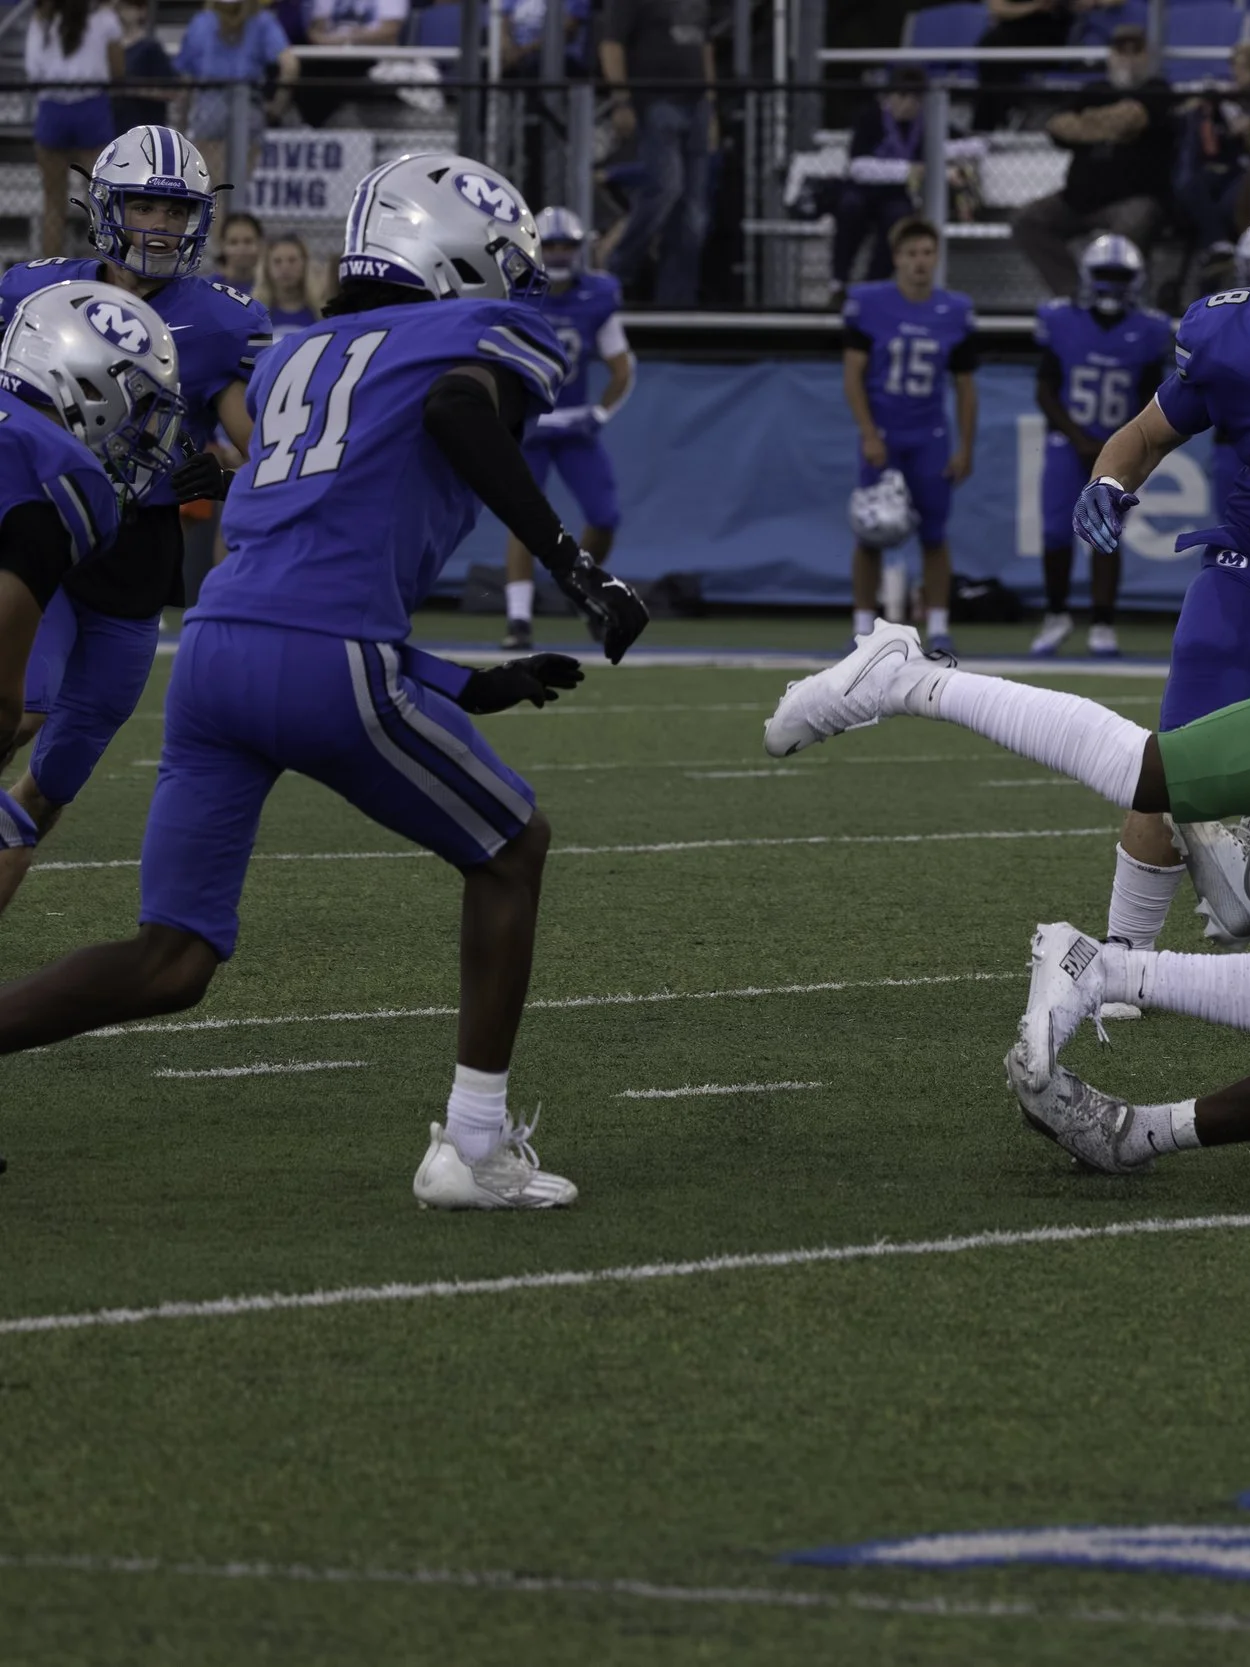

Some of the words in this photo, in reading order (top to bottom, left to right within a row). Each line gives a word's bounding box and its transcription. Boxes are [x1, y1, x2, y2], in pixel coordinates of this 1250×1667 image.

[149, 178, 181, 188] Vikings
[461, 174, 516, 222] M
[89, 303, 149, 353] M
[0, 373, 21, 393] AY
[884, 337, 940, 395] 15
[252, 329, 389, 489] 41
[1068, 366, 1131, 427] 56
[1219, 551, 1245, 568] M
[1060, 936, 1099, 981] NIKE
